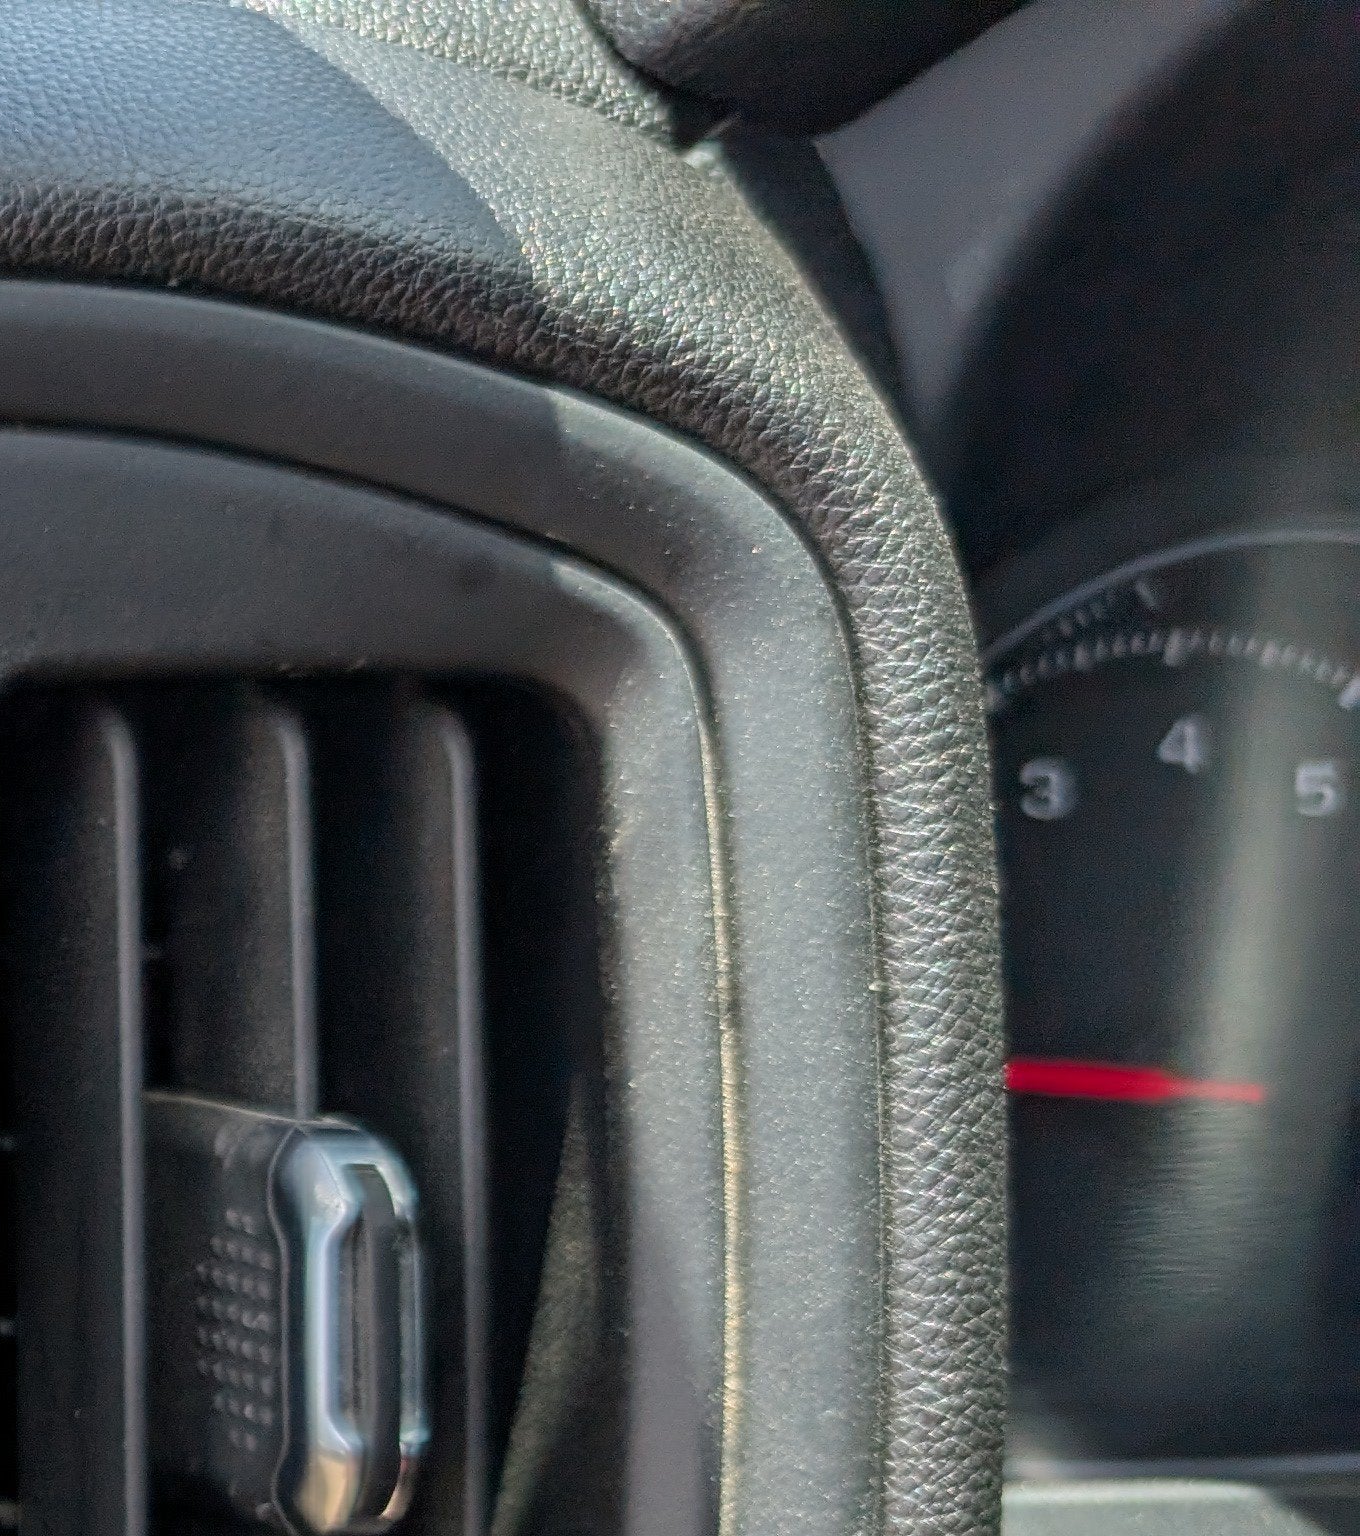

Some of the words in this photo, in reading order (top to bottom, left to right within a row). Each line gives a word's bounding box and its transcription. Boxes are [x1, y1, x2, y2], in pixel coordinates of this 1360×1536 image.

[1156, 714, 1205, 774] 4
[1018, 757, 1077, 820] 3
[1294, 759, 1341, 818] 5
